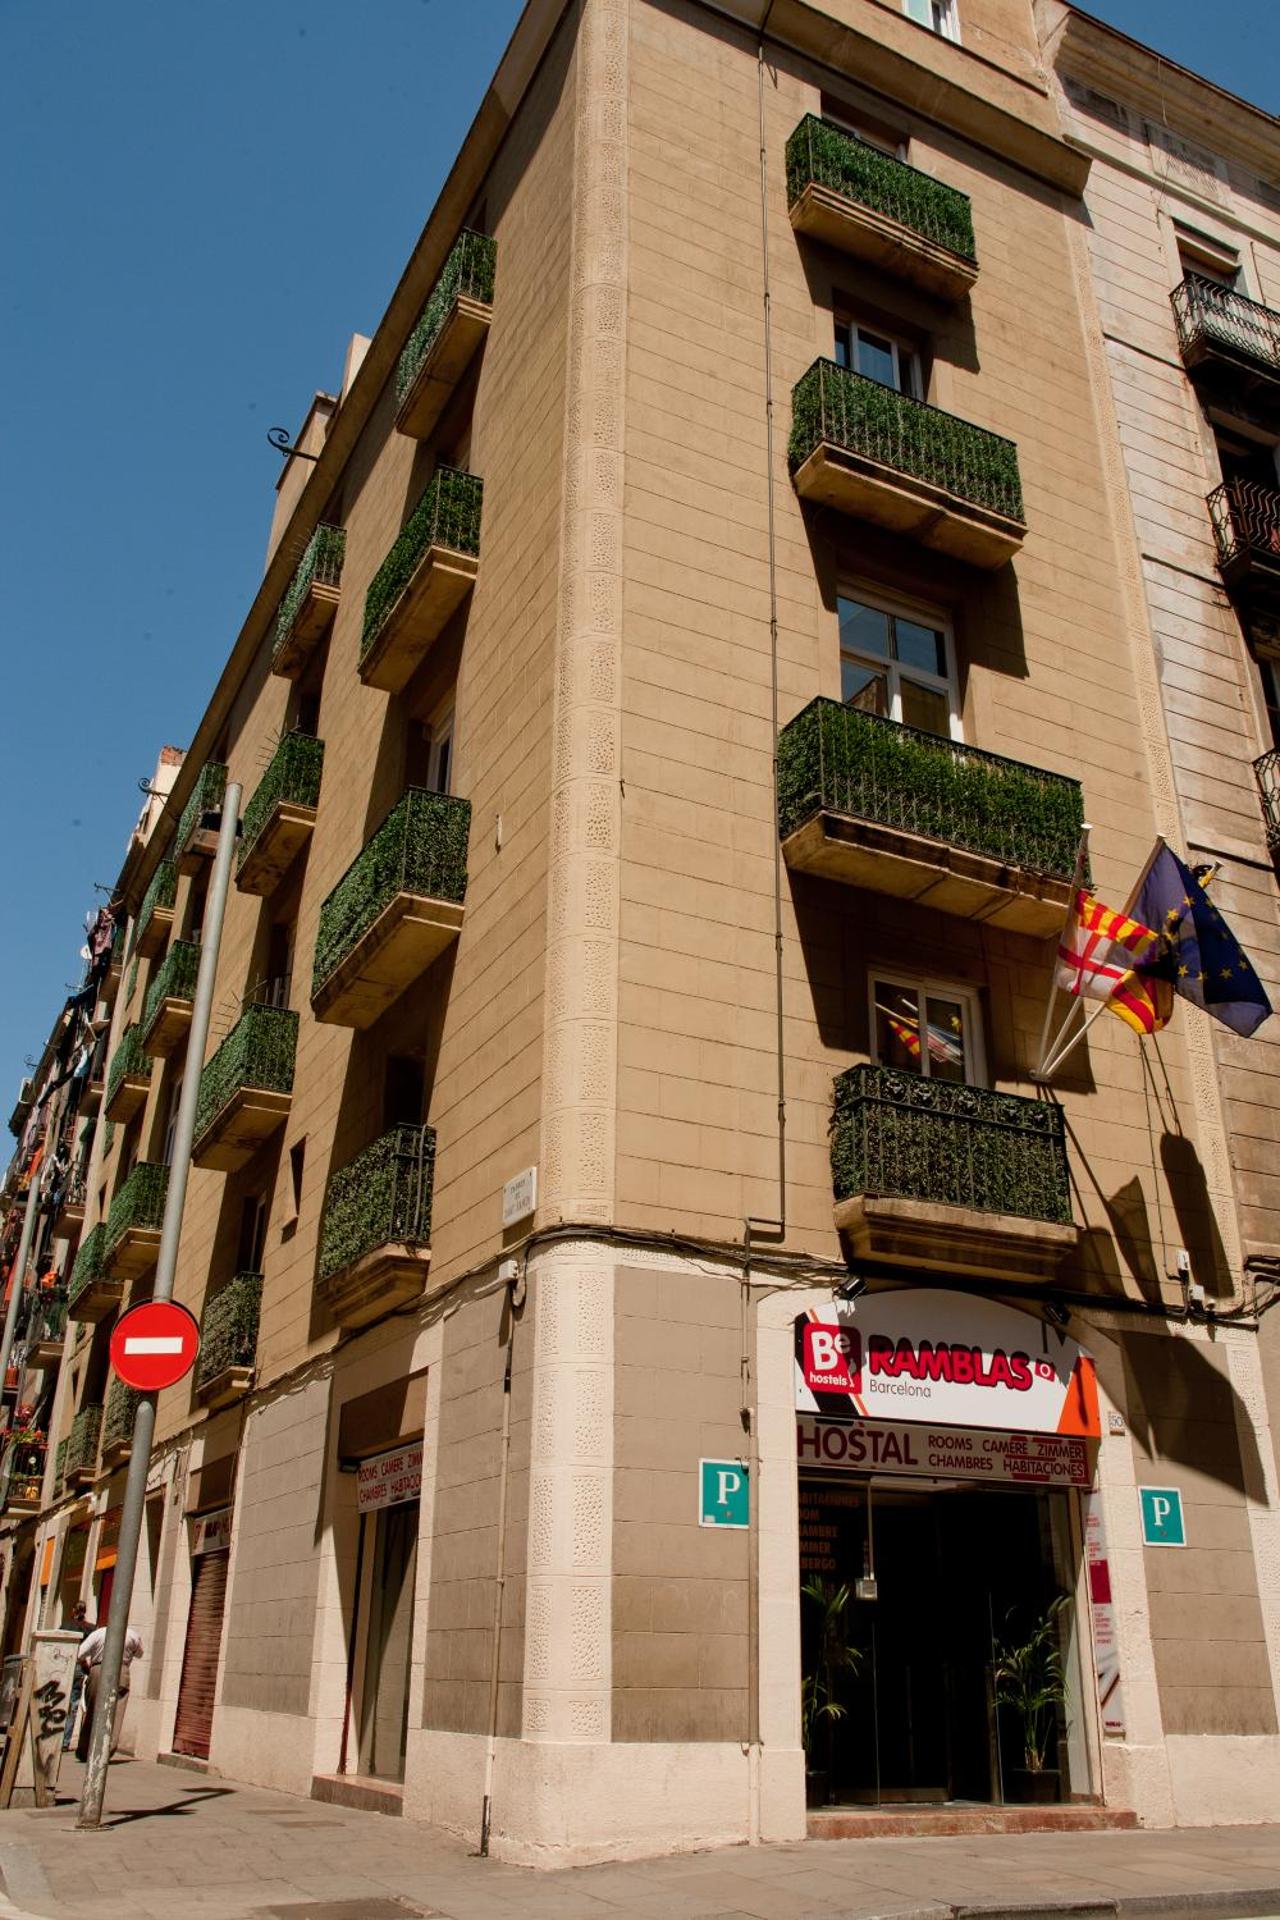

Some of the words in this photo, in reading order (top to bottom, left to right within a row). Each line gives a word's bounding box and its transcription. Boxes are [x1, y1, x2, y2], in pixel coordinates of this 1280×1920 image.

[811, 1331, 850, 1370] Be
[868, 1334, 1034, 1392] RAMBLAS
[809, 1371, 848, 1386] hostels
[869, 1379, 932, 1398] Barcelona
[797, 1425, 919, 1465] HOSTAL
[928, 1434, 973, 1451] ROOMS
[982, 1439, 1028, 1455] CAMERE
[1037, 1443, 1082, 1460] ZIMMER
[928, 1453, 993, 1471] CHAMBRES
[1003, 1458, 1084, 1477] HABITACIONES
[716, 1470, 741, 1505] P
[1151, 1496, 1171, 1526] P
